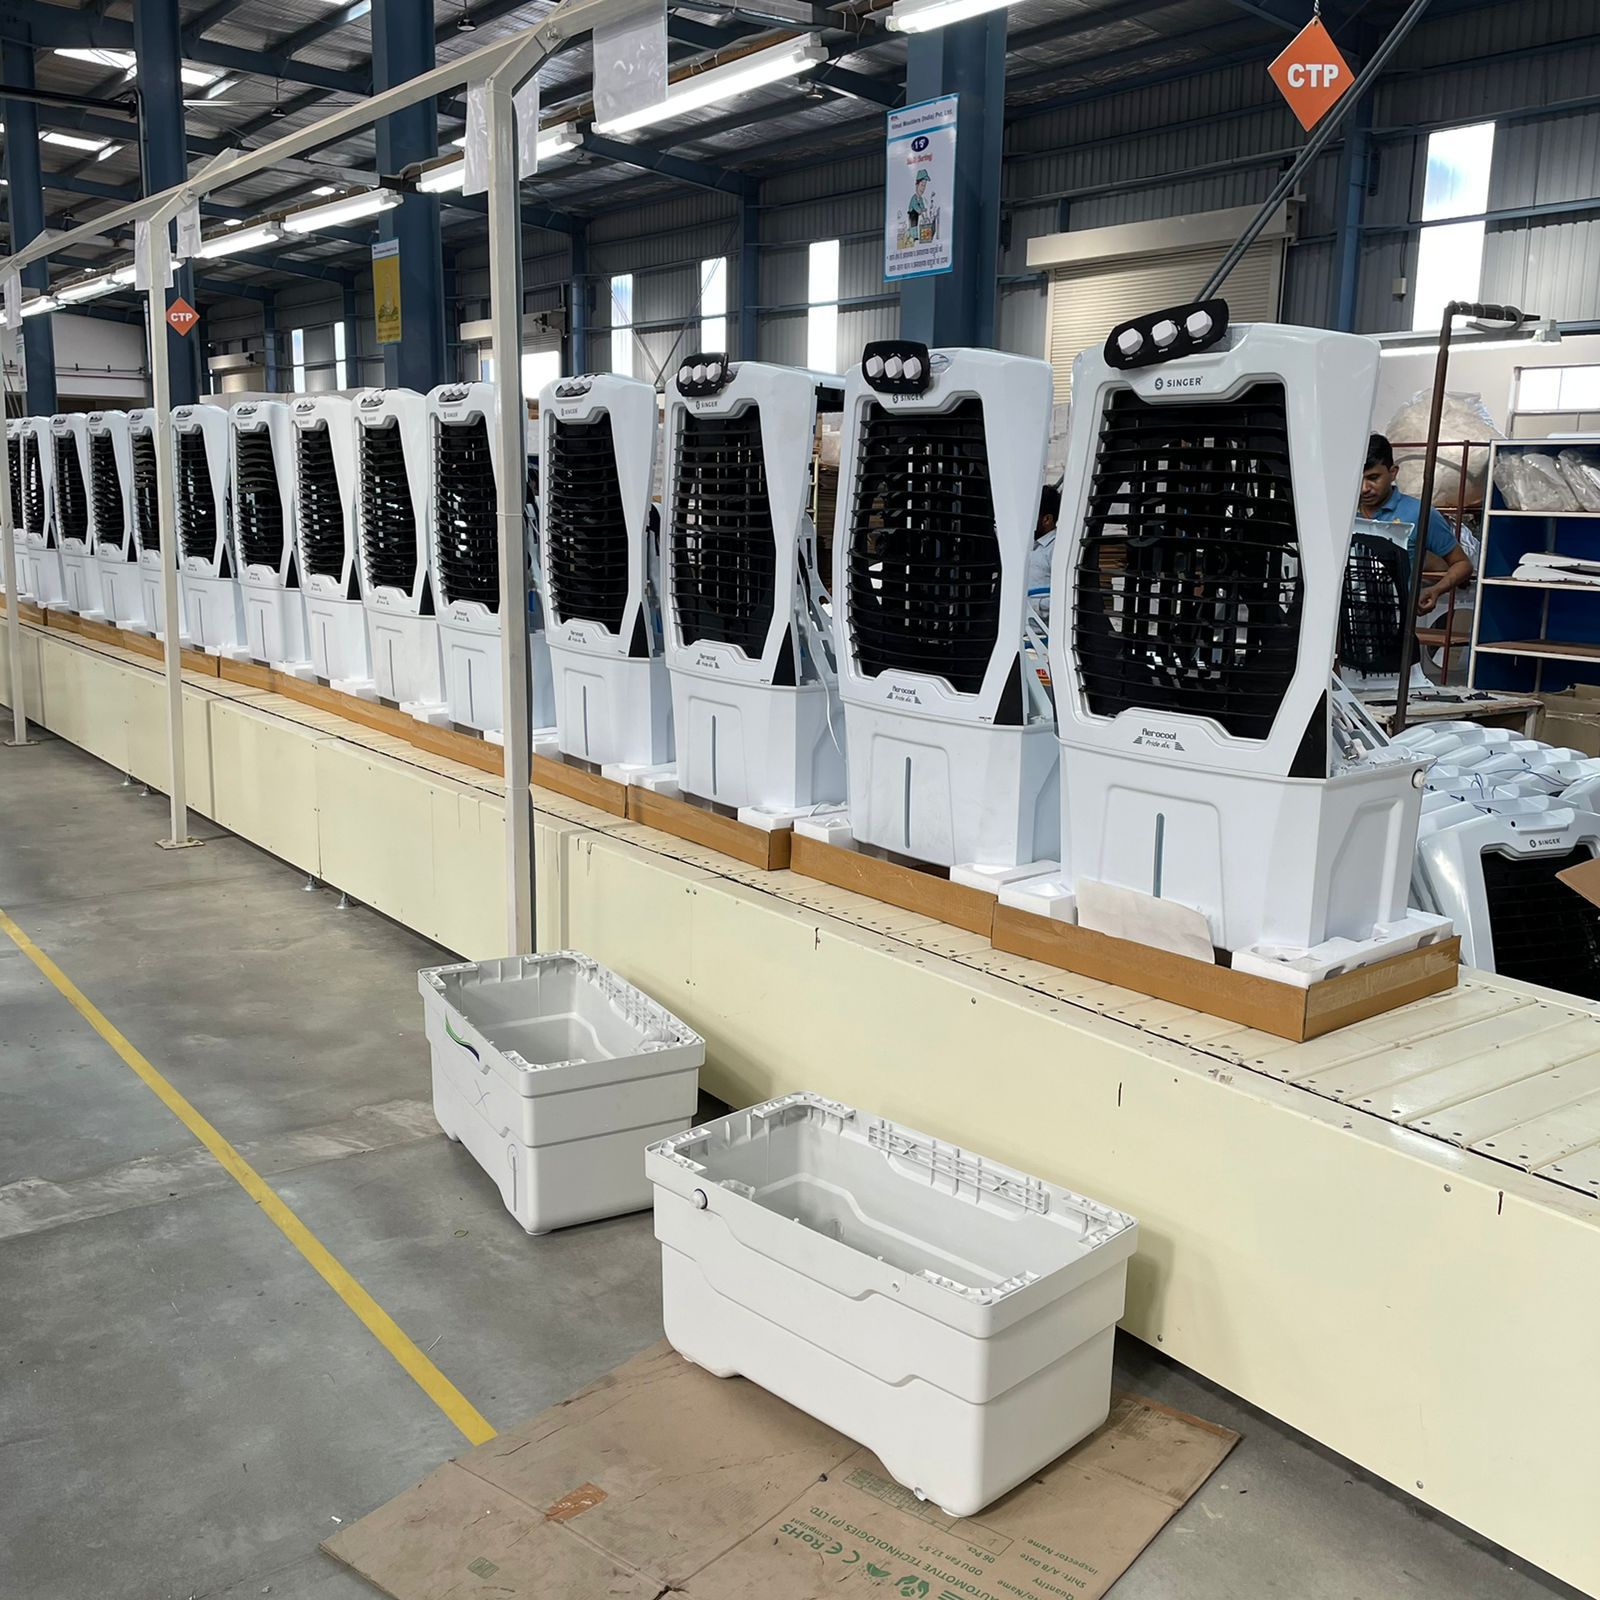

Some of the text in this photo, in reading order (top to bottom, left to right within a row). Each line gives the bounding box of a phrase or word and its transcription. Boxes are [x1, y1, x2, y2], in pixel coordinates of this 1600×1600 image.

[1287, 63, 1339, 88] CTP
[170, 312, 192, 322] CTP
[1167, 378, 1201, 387] SINGER
[1142, 728, 1177, 740] Aerocool
[827, 1515, 846, 1528] (P)
[779, 1524, 825, 1550] RoHS
[843, 1524, 922, 1567] TECHNOLOGIES
[1027, 1538, 1053, 1554] Name
[945, 1554, 961, 1566] Fan
[983, 1554, 995, 1564] 06
[1020, 1553, 1041, 1567] Date
[1054, 1552, 1098, 1575] Inspector
[1032, 1577, 1075, 1600] Quantity
